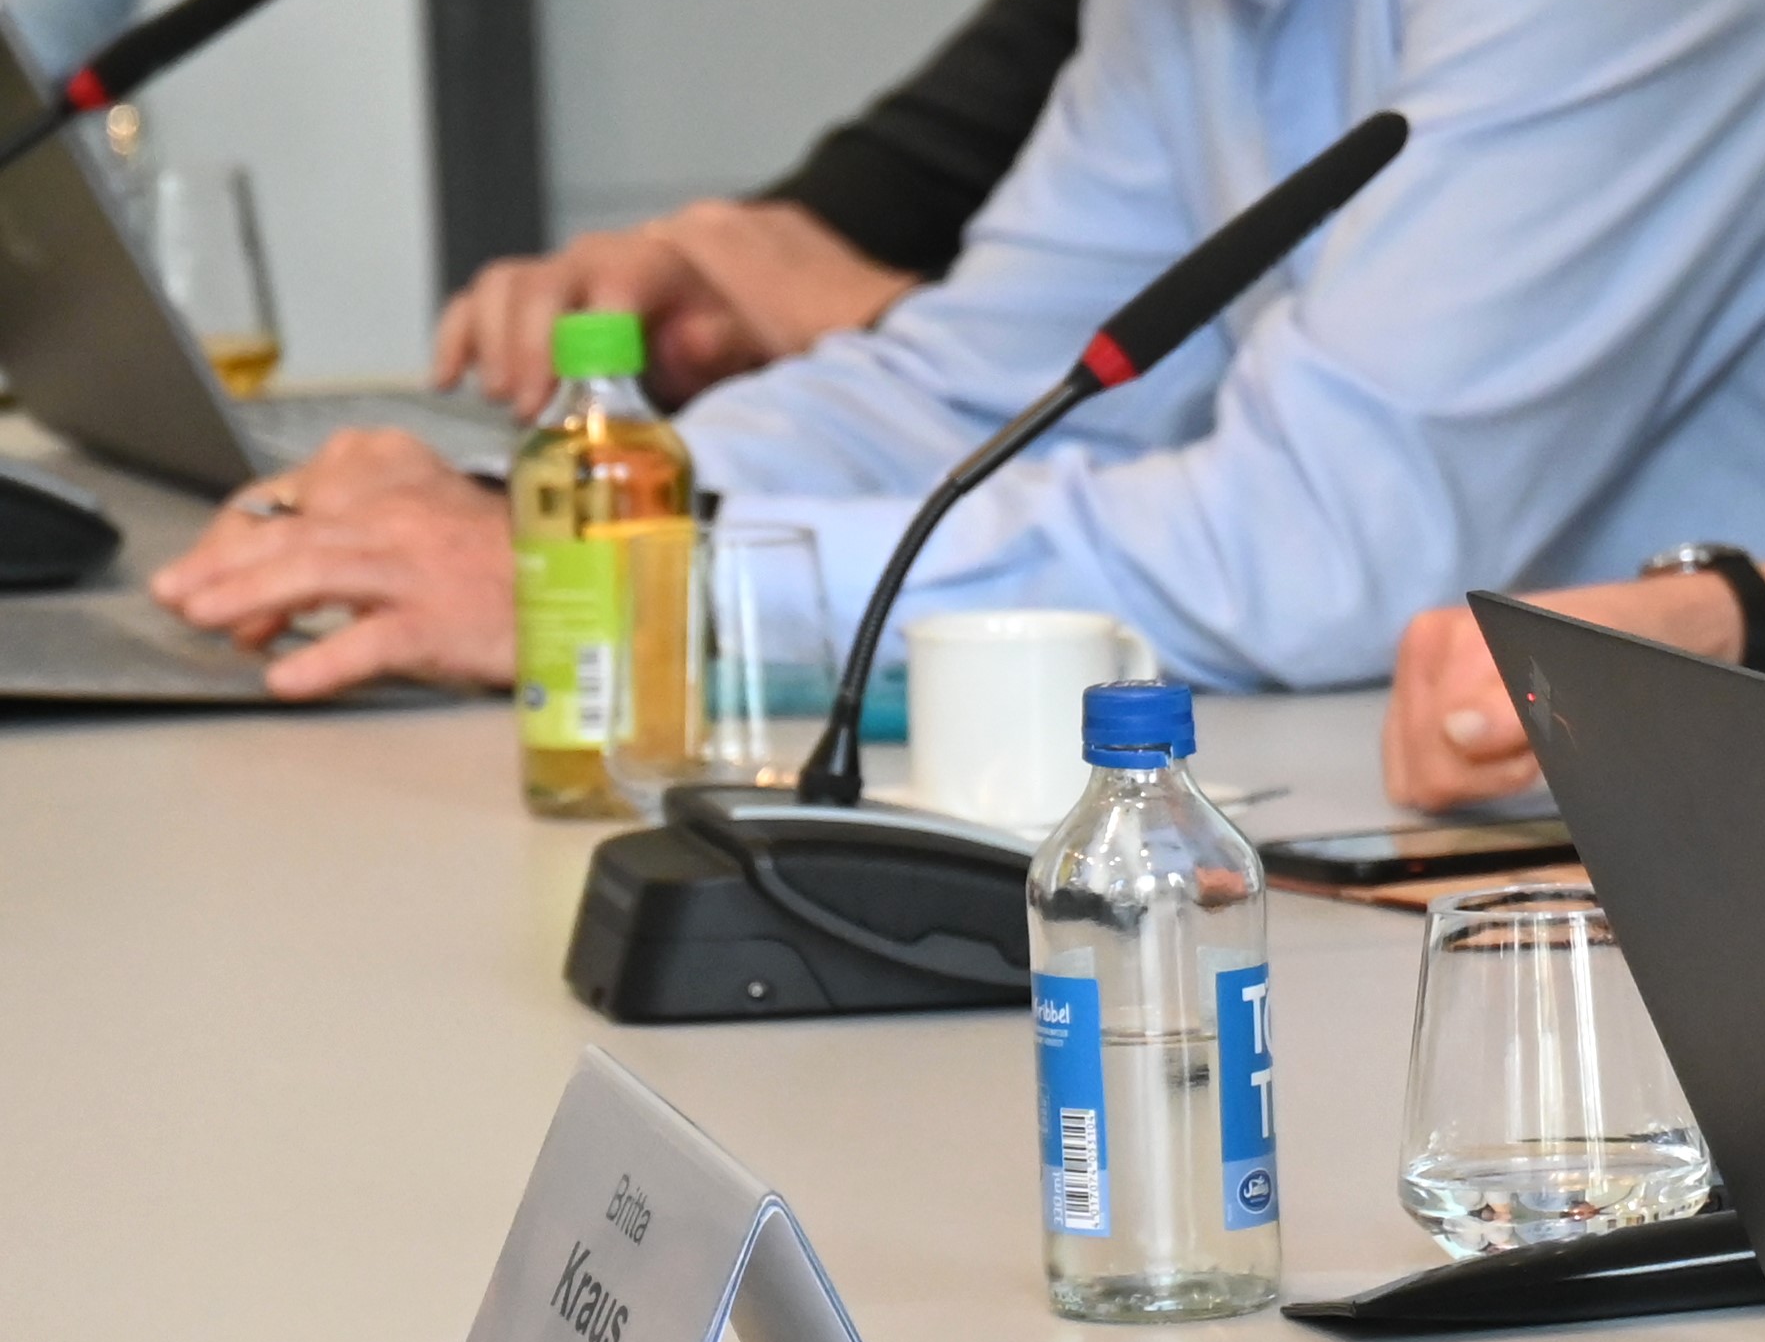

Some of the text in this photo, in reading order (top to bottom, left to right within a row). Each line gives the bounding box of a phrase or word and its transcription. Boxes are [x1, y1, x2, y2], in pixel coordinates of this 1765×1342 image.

[1034, 997, 1070, 1025] ribbel
[1242, 977, 1272, 1054] T
[606, 1174, 651, 1246] Britta
